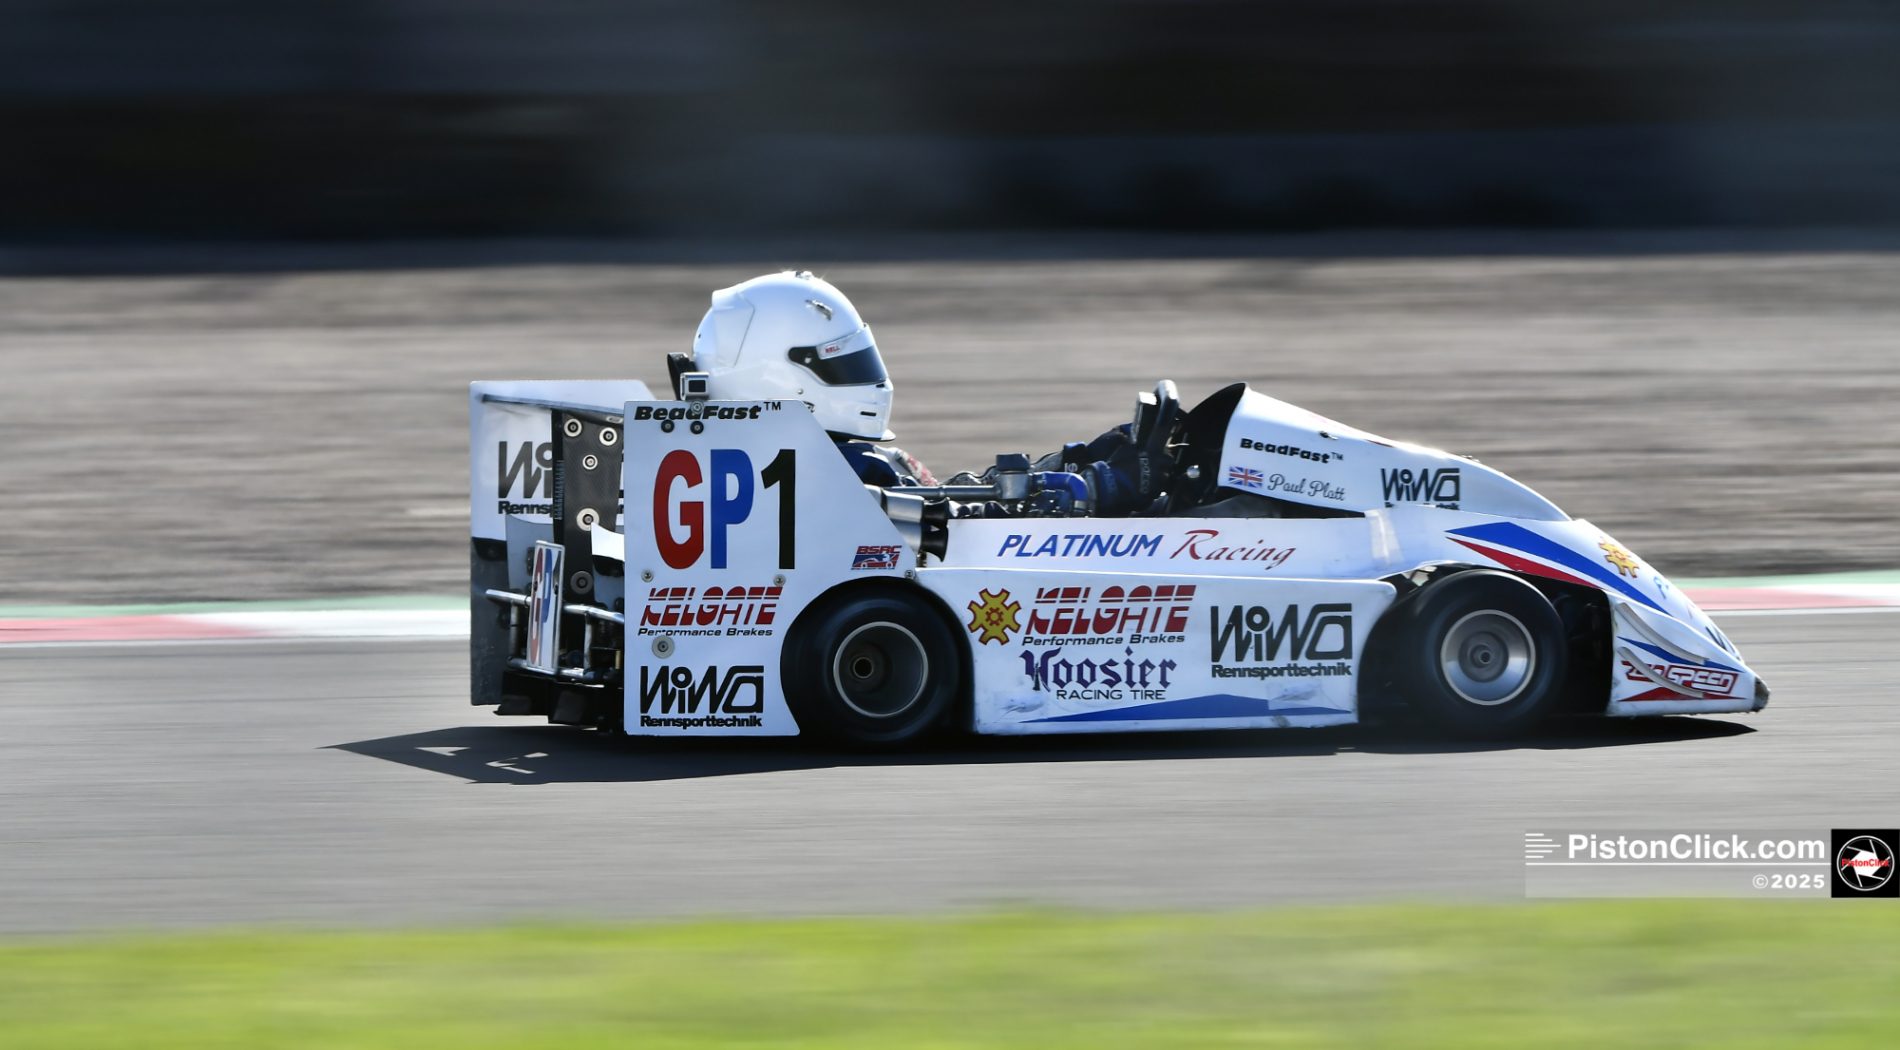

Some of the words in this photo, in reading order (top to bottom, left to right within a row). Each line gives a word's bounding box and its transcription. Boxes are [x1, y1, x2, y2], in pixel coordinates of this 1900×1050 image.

[1267, 473, 1306, 494] Paul
[1308, 480, 1345, 501] Platt
[653, 449, 796, 570] GP1
[997, 533, 1163, 558] PLATINUM
[1170, 528, 1296, 570] Racing
[530, 548, 562, 665] GP1
[640, 586, 783, 626] KELGATE
[1026, 584, 1197, 635] KELGATE
[638, 627, 722, 637] Perormance
[726, 627, 773, 636] Brakes
[1021, 635, 1125, 647] Performance
[1129, 633, 1185, 645] Brakes
[1019, 646, 1178, 692] Hoosier
[1211, 664, 1352, 681] Rennsporttechnik
[1056, 690, 1124, 700] RACING
[1131, 690, 1166, 700] TIRE
[640, 715, 763, 730] Rennsporttechnik
